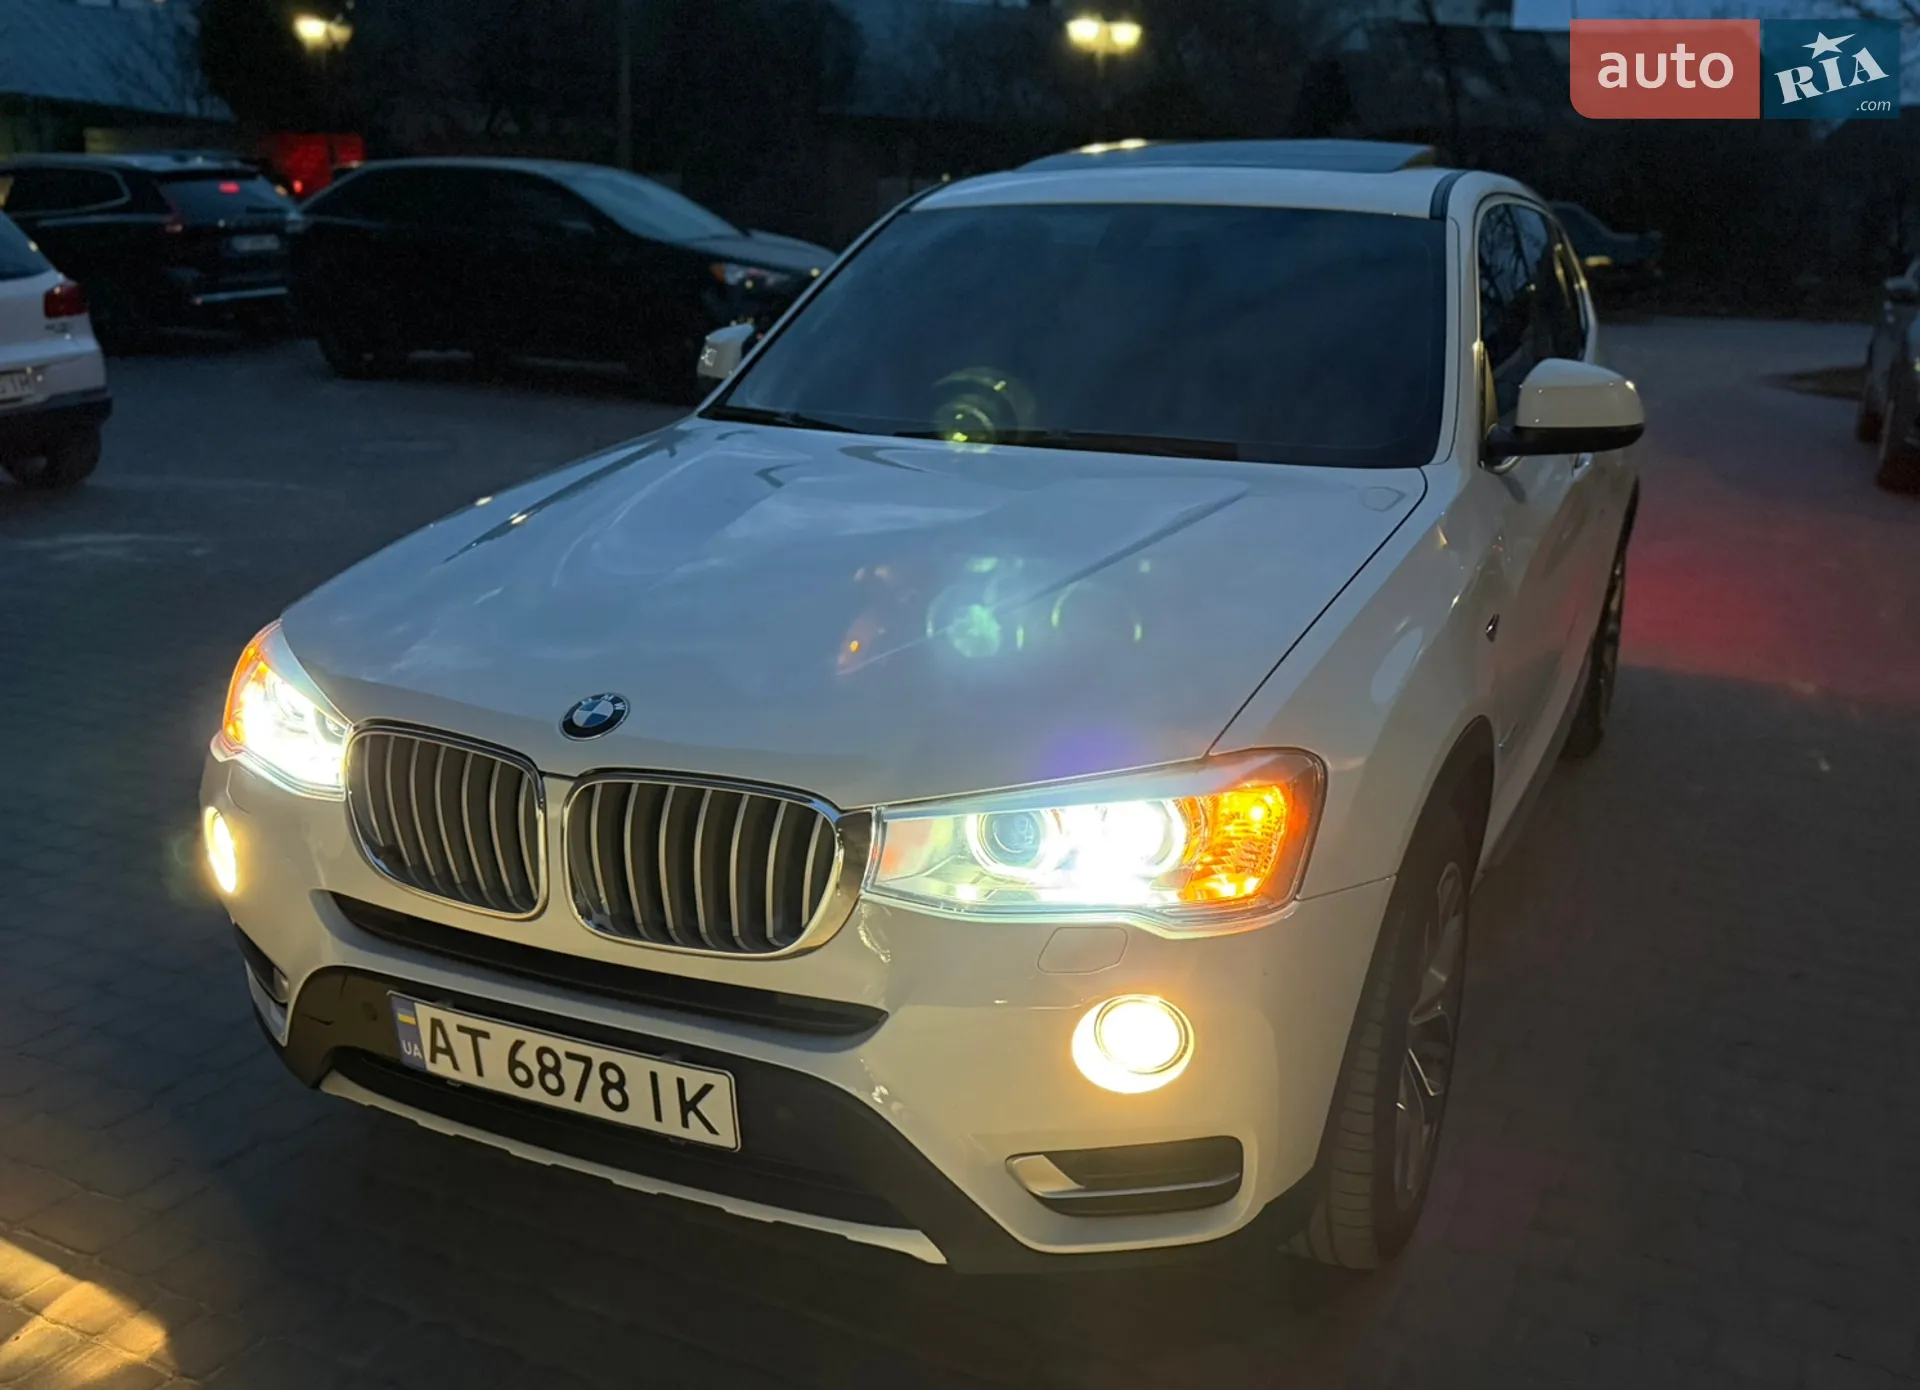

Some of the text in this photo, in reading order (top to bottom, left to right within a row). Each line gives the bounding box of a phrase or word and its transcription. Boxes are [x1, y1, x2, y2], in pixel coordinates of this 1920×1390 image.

[402, 1040, 424, 1060] UA
[429, 1017, 720, 1136] AT 6878 IK
